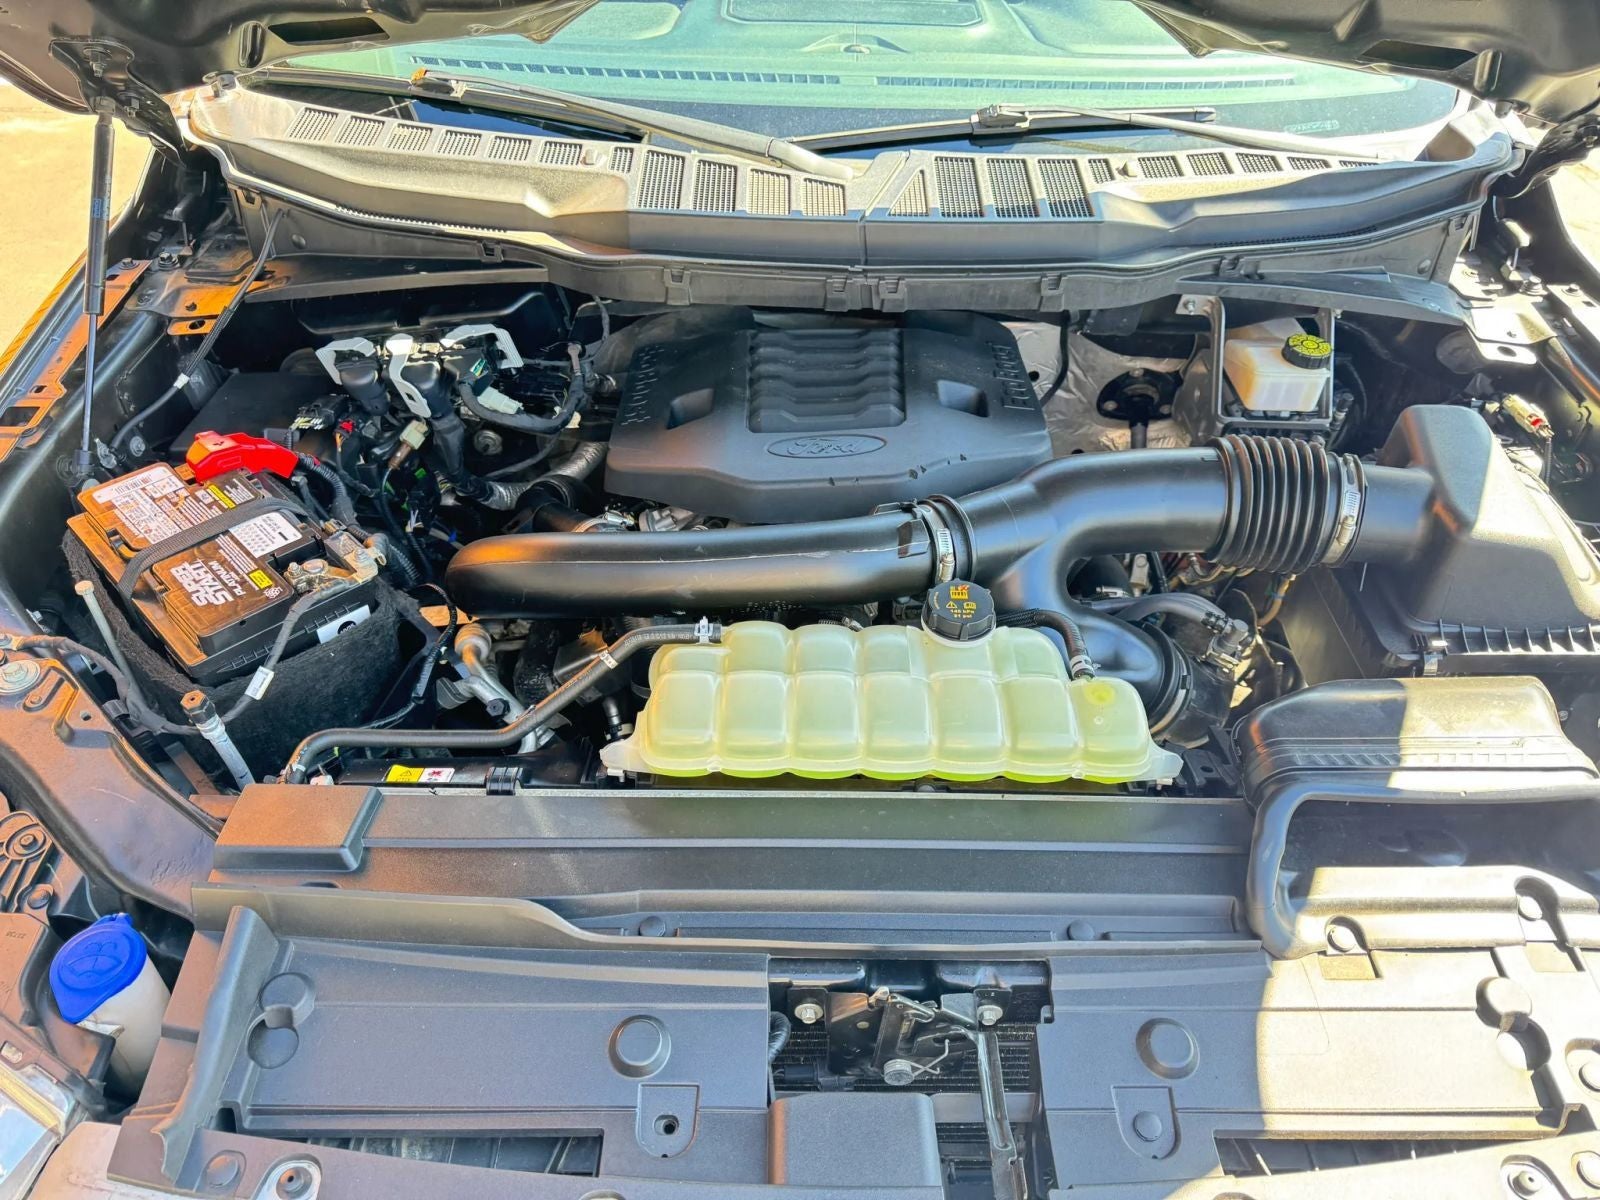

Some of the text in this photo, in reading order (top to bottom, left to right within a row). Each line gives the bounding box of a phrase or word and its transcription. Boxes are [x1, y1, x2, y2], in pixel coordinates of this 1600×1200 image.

[170, 562, 208, 606] SUPER
[186, 559, 234, 605] START
[208, 560, 246, 596] PLATINUM
